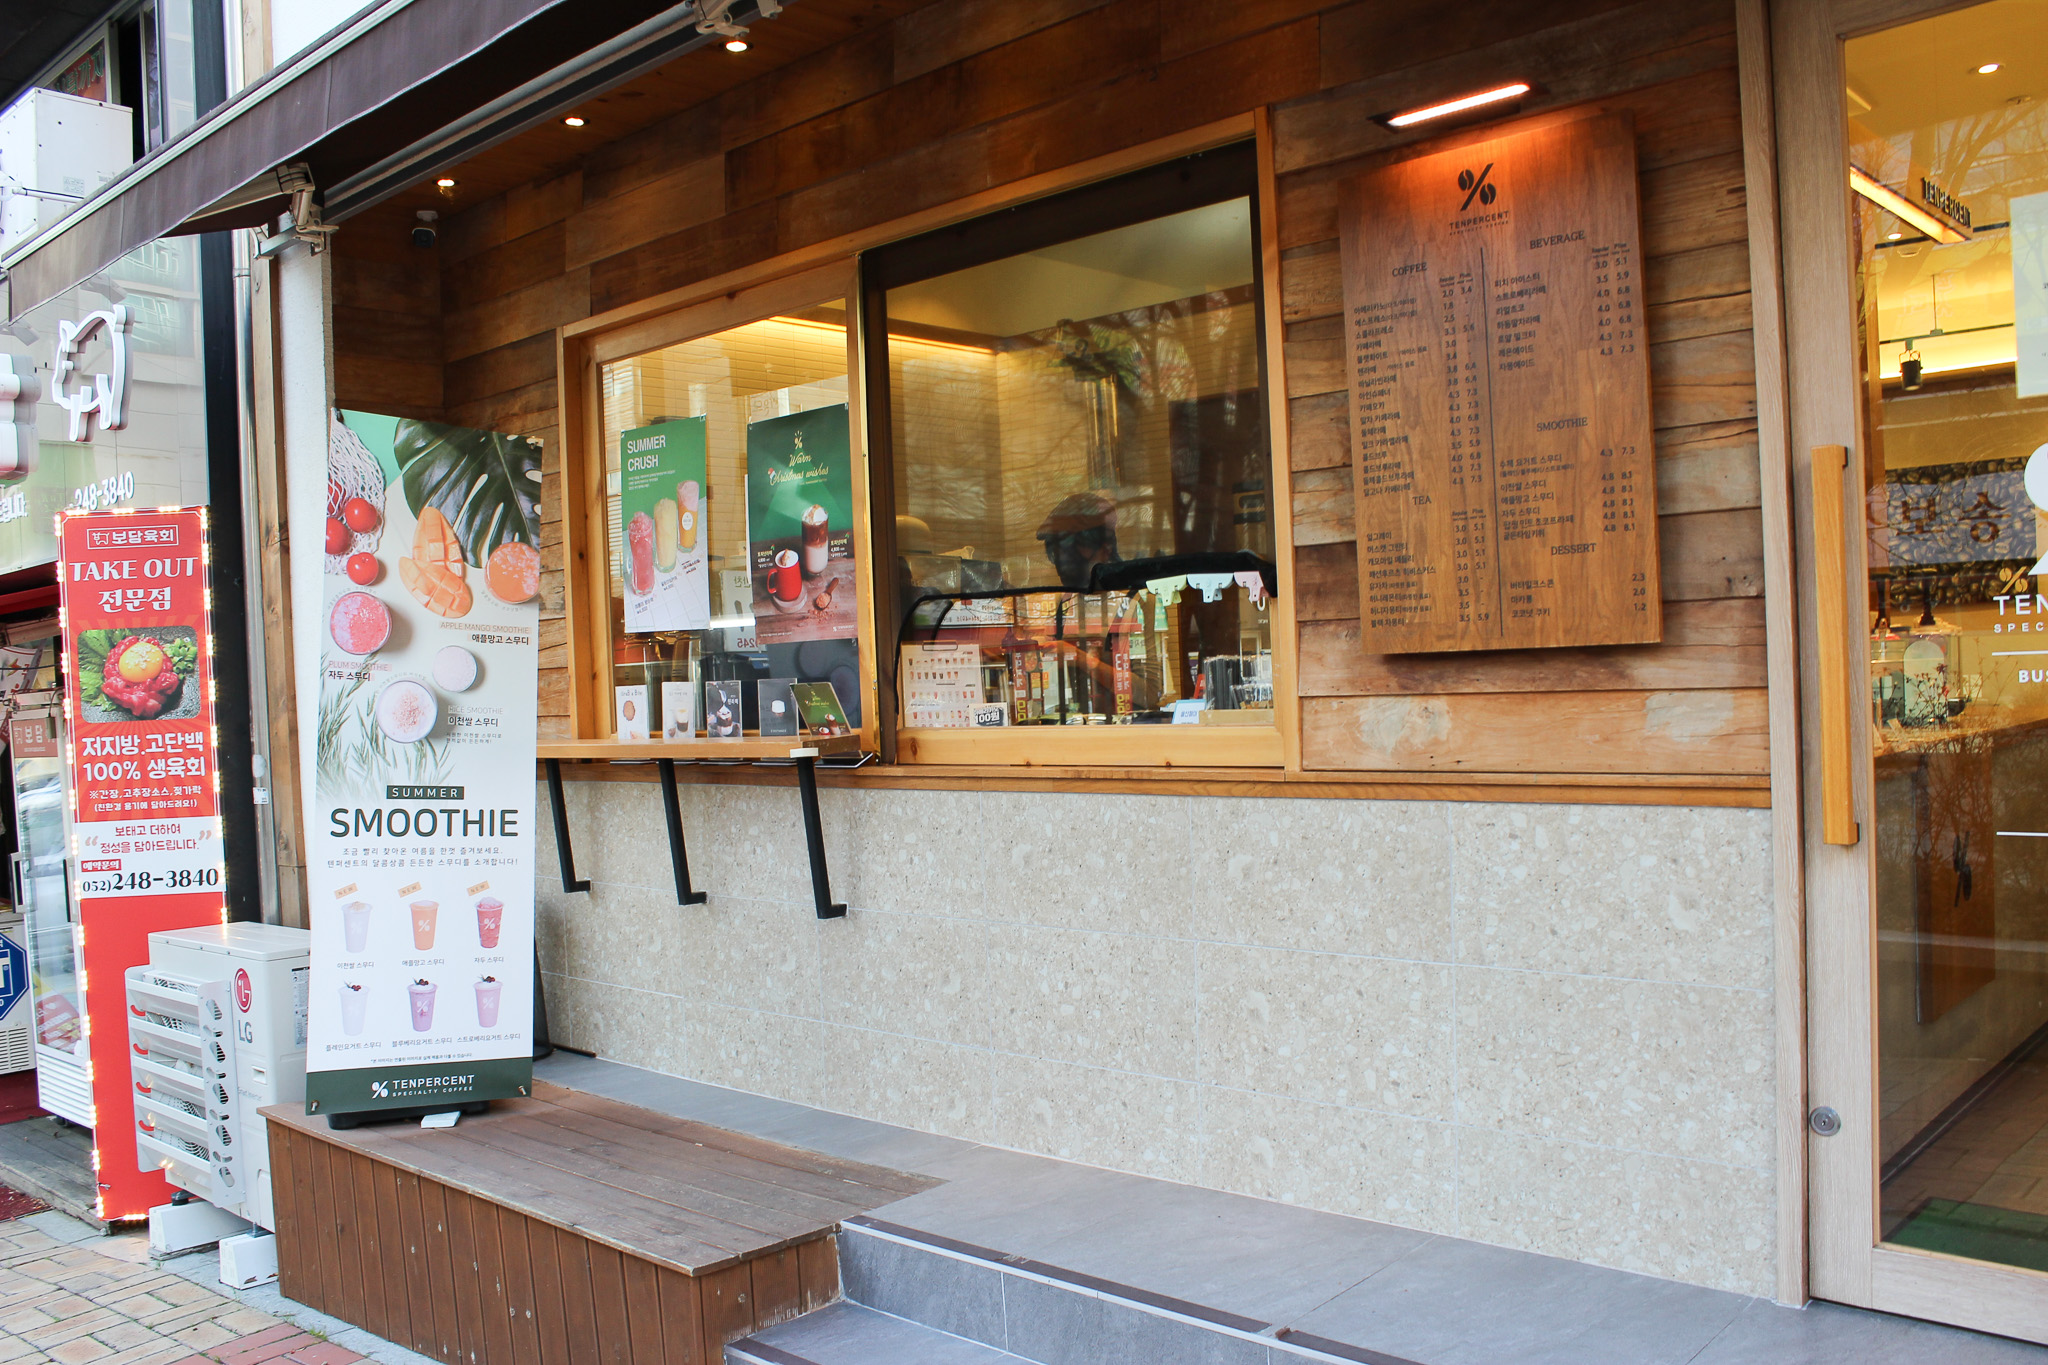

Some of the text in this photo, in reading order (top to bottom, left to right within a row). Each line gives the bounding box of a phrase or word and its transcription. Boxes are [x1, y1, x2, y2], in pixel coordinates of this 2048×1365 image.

[1920, 177, 1971, 228] TENPERCENT
[1449, 210, 1509, 230] TENPERCENT
[1530, 230, 1585, 249] BEVERAGE
[1392, 262, 1427, 277] COFFEE
[1536, 417, 1588, 432] SMOOTHIE
[627, 434, 666, 454] SUMMER
[628, 454, 659, 472] CRUSH
[789, 452, 812, 467] Warm
[1540, 453, 1562, 465] 스무디
[769, 468, 805, 486] Christmas
[805, 462, 829, 478] wishes
[1525, 480, 1546, 490] 스무디
[1412, 495, 1432, 505] TEA
[1533, 491, 1554, 501] 스무디
[1518, 506, 1540, 517] 스무디
[111, 529, 174, 545] 보담육회
[1551, 542, 1597, 556] DESSERT
[69, 556, 199, 582] TAKE OUT
[1632, 573, 1645, 582] 2.3
[1633, 588, 1646, 596] 2.0
[98, 586, 171, 613] 전문점
[1634, 602, 1647, 611] 1.2
[440, 621, 529, 634] APPLE MANGO SMOOTHIE
[472, 633, 529, 645] 애플망고 스무디
[328, 660, 388, 671] PLUM SMOOTHIE
[329, 670, 371, 681] 자두 스무디
[449, 705, 503, 714] RICE SMOOTHIE
[448, 716, 499, 727] 이천쌀 스무디
[975, 711, 1000, 724] 100원
[82, 731, 204, 757] 저지방.고단백
[82, 756, 206, 782] 100% 생육회
[391, 787, 458, 798] SUMMER
[94, 798, 198, 812] (친환경 용기에 담아드려요!)
[330, 808, 519, 838] SMOOTHIE
[115, 823, 181, 837] 보태고 더하여
[100, 838, 200, 854] 정성을 담아드립니다.
[343, 847, 359, 856] 조금
[363, 847, 379, 856] 빨리
[383, 847, 407, 856] 찾아온
[411, 847, 436, 856] 여름을
[440, 847, 456, 855] 한껏
[82, 859, 120, 871] 예약문의
[327, 857, 519, 869] 텐퍼센트의 달콤상콤 든든한 스무디를 소개합니다!
[83, 867, 219, 893] 052)248-3840
[337, 886, 354, 897] NEW
[401, 885, 418, 895] NEW
[469, 883, 486, 894] NEW
[337, 961, 374, 970] 이천쌀 스무디
[402, 958, 445, 967] 애플망고 스무디
[474, 955, 504, 964] 자두 스무디
[237, 1019, 253, 1044] LG
[326, 1041, 382, 1052] 플레인요거트 스무디
[392, 1037, 452, 1047] 블루베리요거트 스무디
[392, 1074, 475, 1090] TENPERCENT
[392, 1085, 473, 1098] SPECIALTY COFFEE
